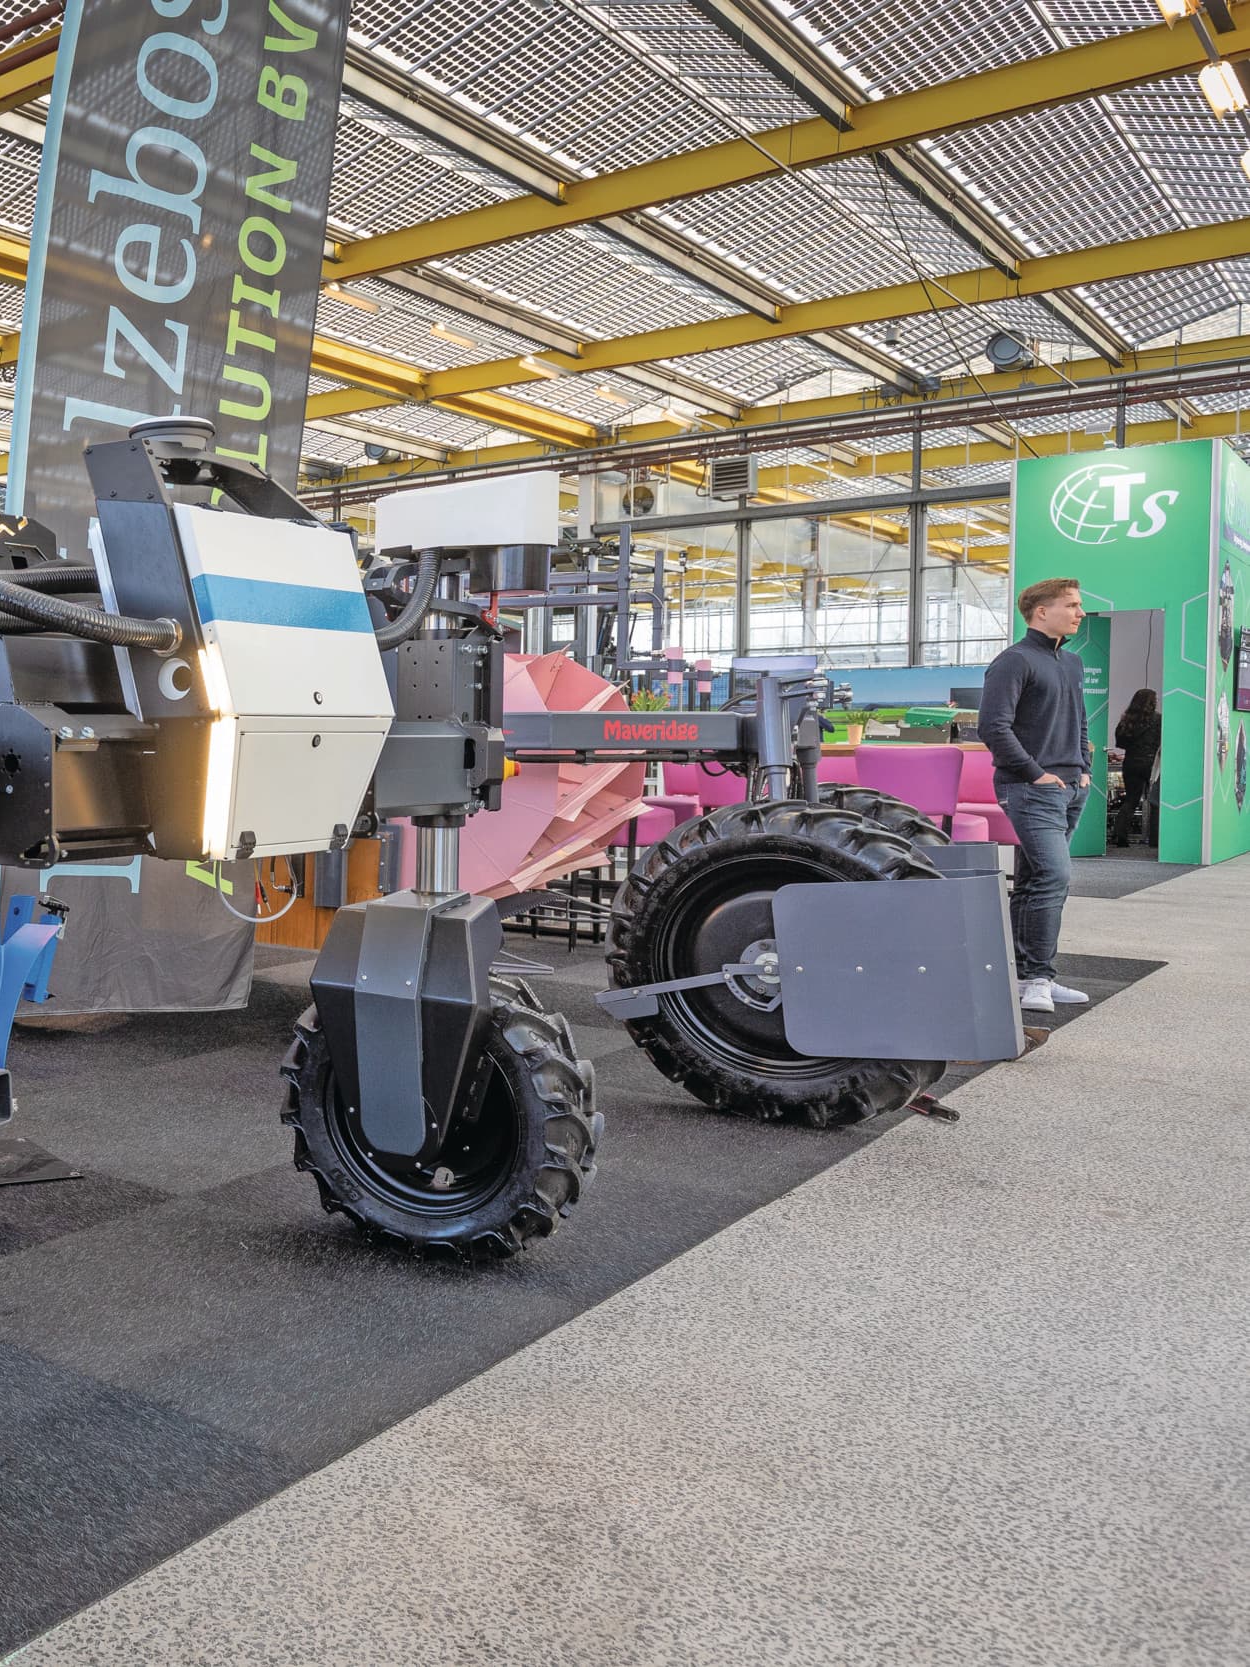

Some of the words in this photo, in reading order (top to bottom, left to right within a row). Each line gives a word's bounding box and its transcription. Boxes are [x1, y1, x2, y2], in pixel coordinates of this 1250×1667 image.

[214, 143, 299, 480] LUTION
[257, 0, 318, 120] BV
[603, 719, 699, 742] Maveridge
